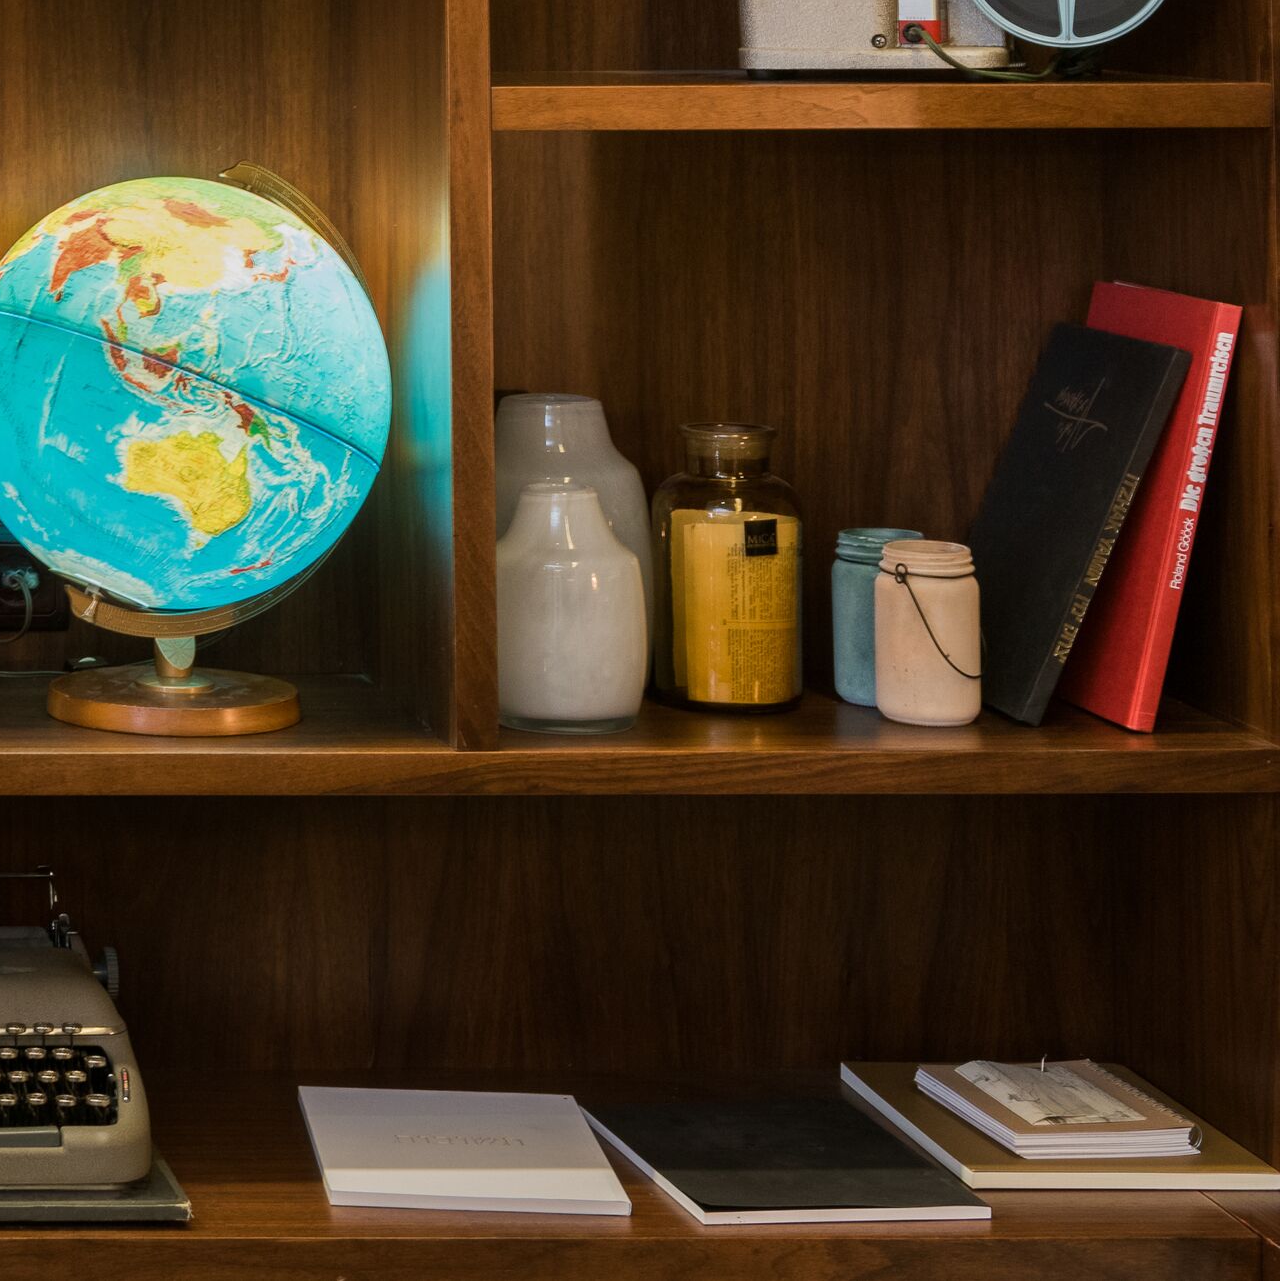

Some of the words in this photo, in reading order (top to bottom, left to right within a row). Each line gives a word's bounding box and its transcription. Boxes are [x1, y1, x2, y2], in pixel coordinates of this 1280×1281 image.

[1178, 484, 1201, 513] Die
[1197, 331, 1234, 426] Traumreisen
[1104, 473, 1140, 534] ITZHAK
[1083, 538, 1116, 587] YAMIN
[1169, 552, 1187, 591] Roland
